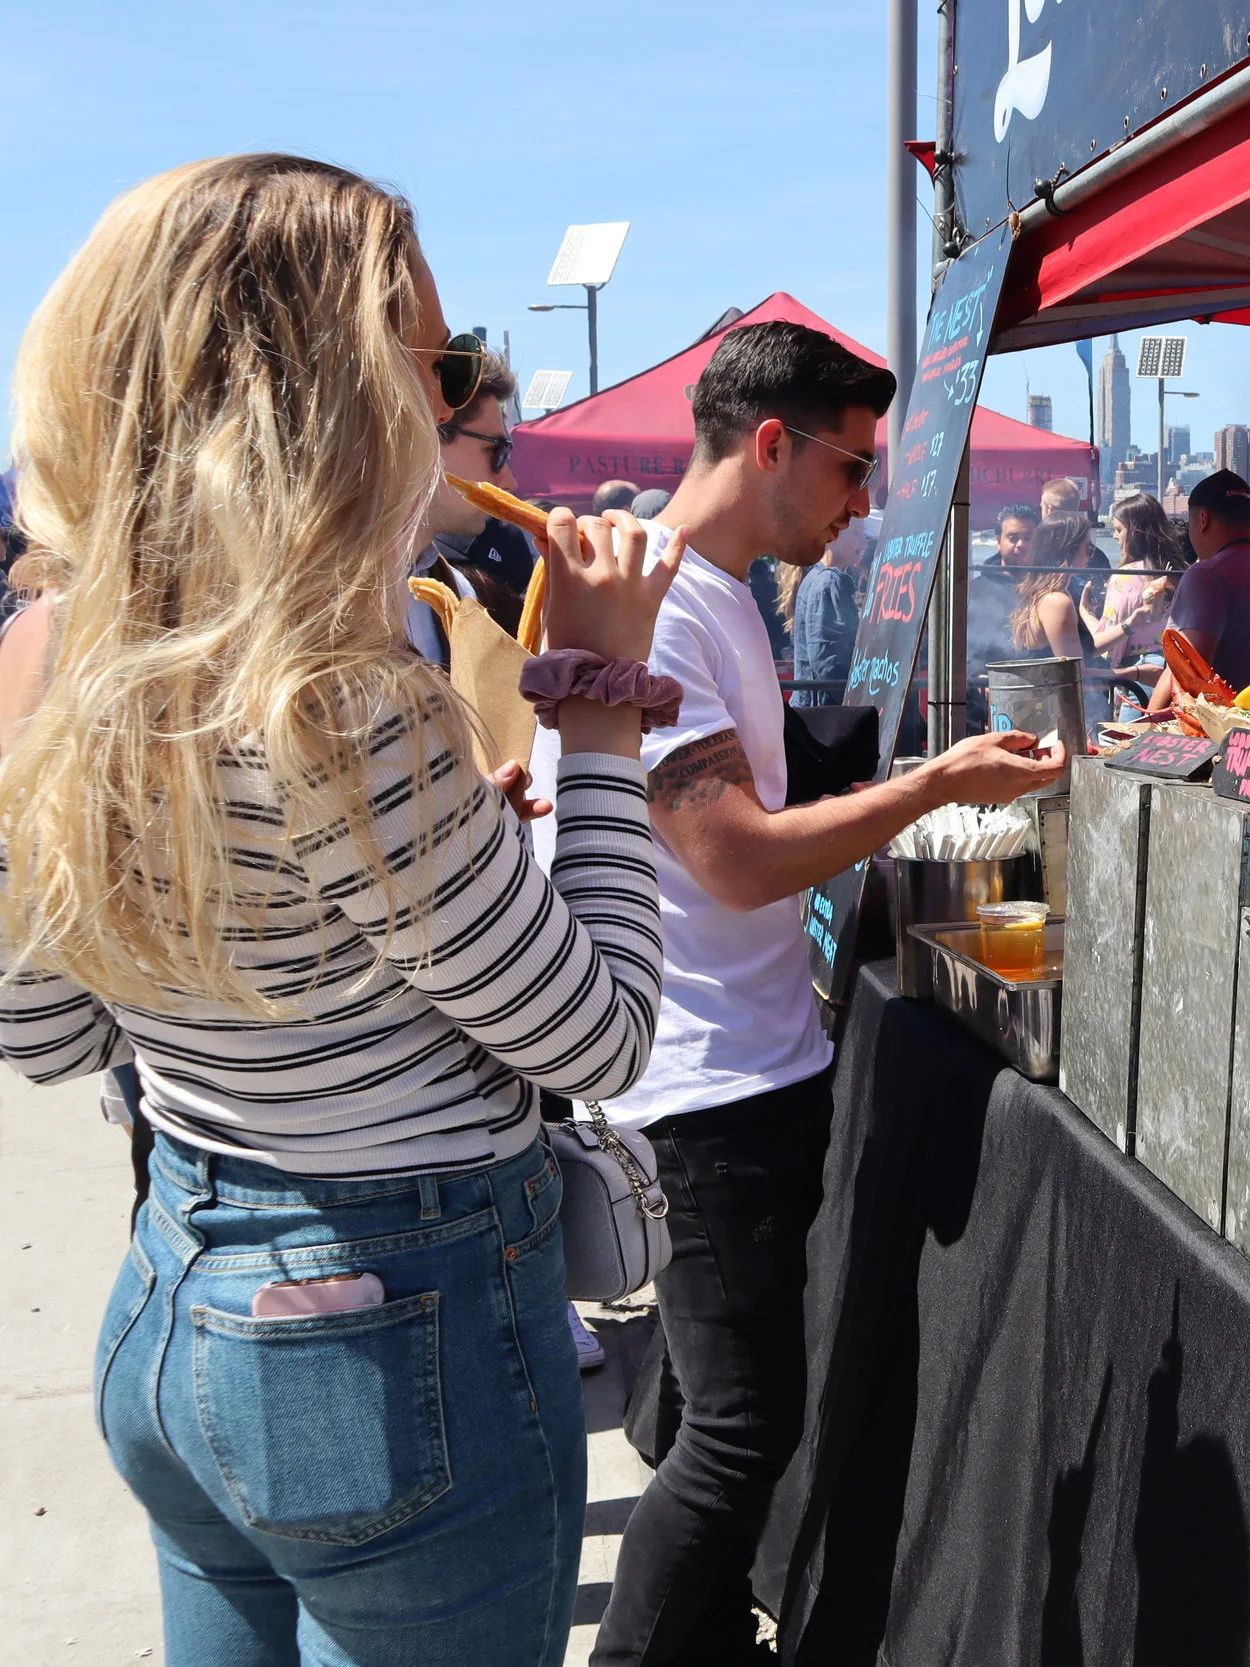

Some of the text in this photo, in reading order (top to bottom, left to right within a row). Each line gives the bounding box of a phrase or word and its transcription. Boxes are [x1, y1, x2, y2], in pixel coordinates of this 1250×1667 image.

[569, 455, 664, 475] PASTURE
[869, 561, 922, 625] FRIES
[1143, 735, 1212, 754] LOBSTER
[1131, 748, 1199, 767] NEST
